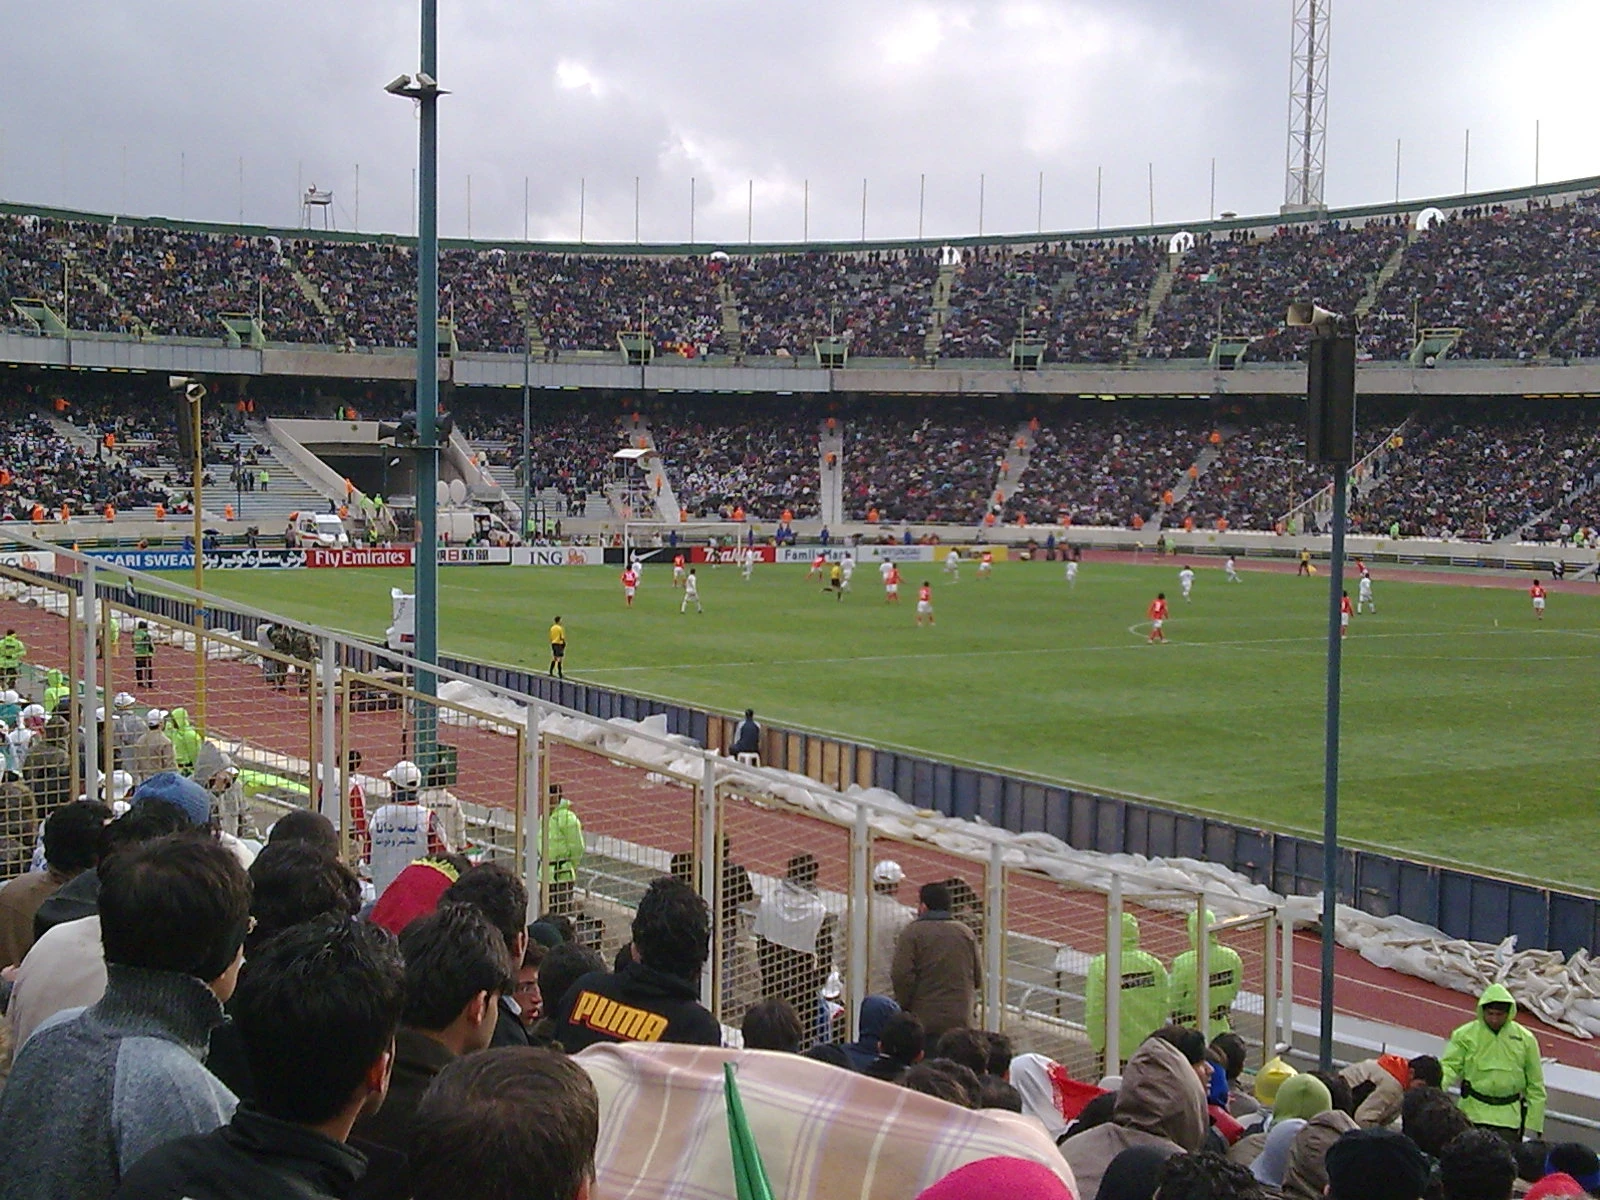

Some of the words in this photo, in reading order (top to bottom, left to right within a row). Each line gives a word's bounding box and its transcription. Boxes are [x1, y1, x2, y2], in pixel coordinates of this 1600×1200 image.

[144, 554, 196, 567] SWEAT
[280, 550, 308, 568] فرش
[315, 550, 340, 568] Fly
[342, 550, 406, 565] Emirates
[530, 551, 563, 565] ING
[572, 991, 669, 1042] PUMA
